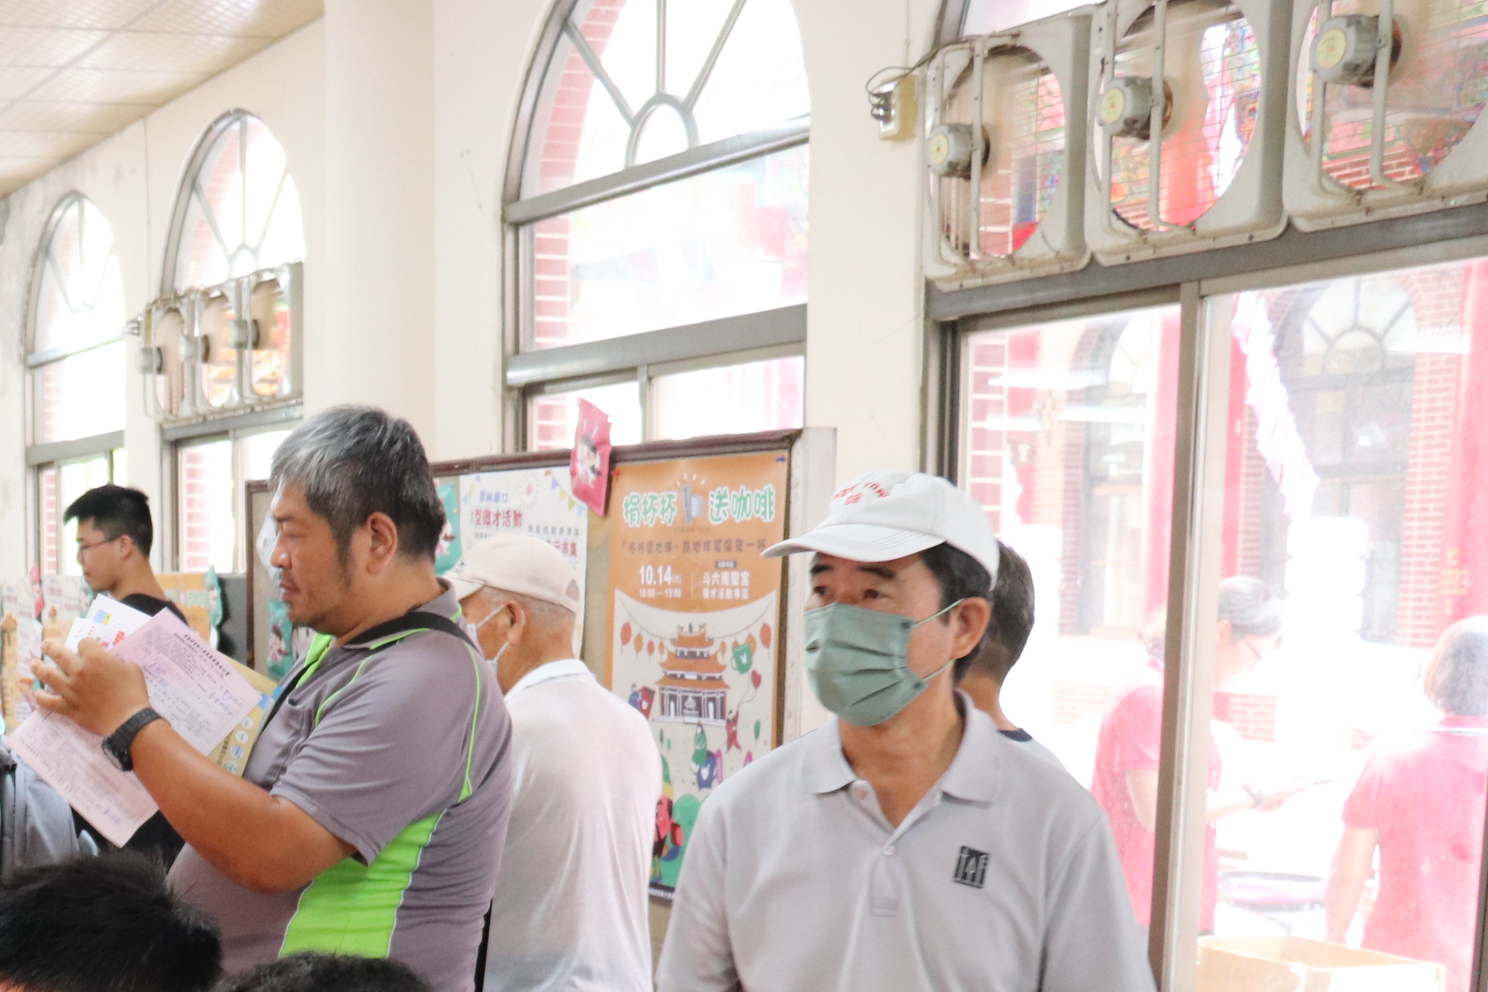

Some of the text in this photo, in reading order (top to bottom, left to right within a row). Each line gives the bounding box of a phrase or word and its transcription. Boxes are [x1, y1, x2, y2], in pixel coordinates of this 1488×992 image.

[623, 484, 776, 527] 捐杯杯 送咖啡
